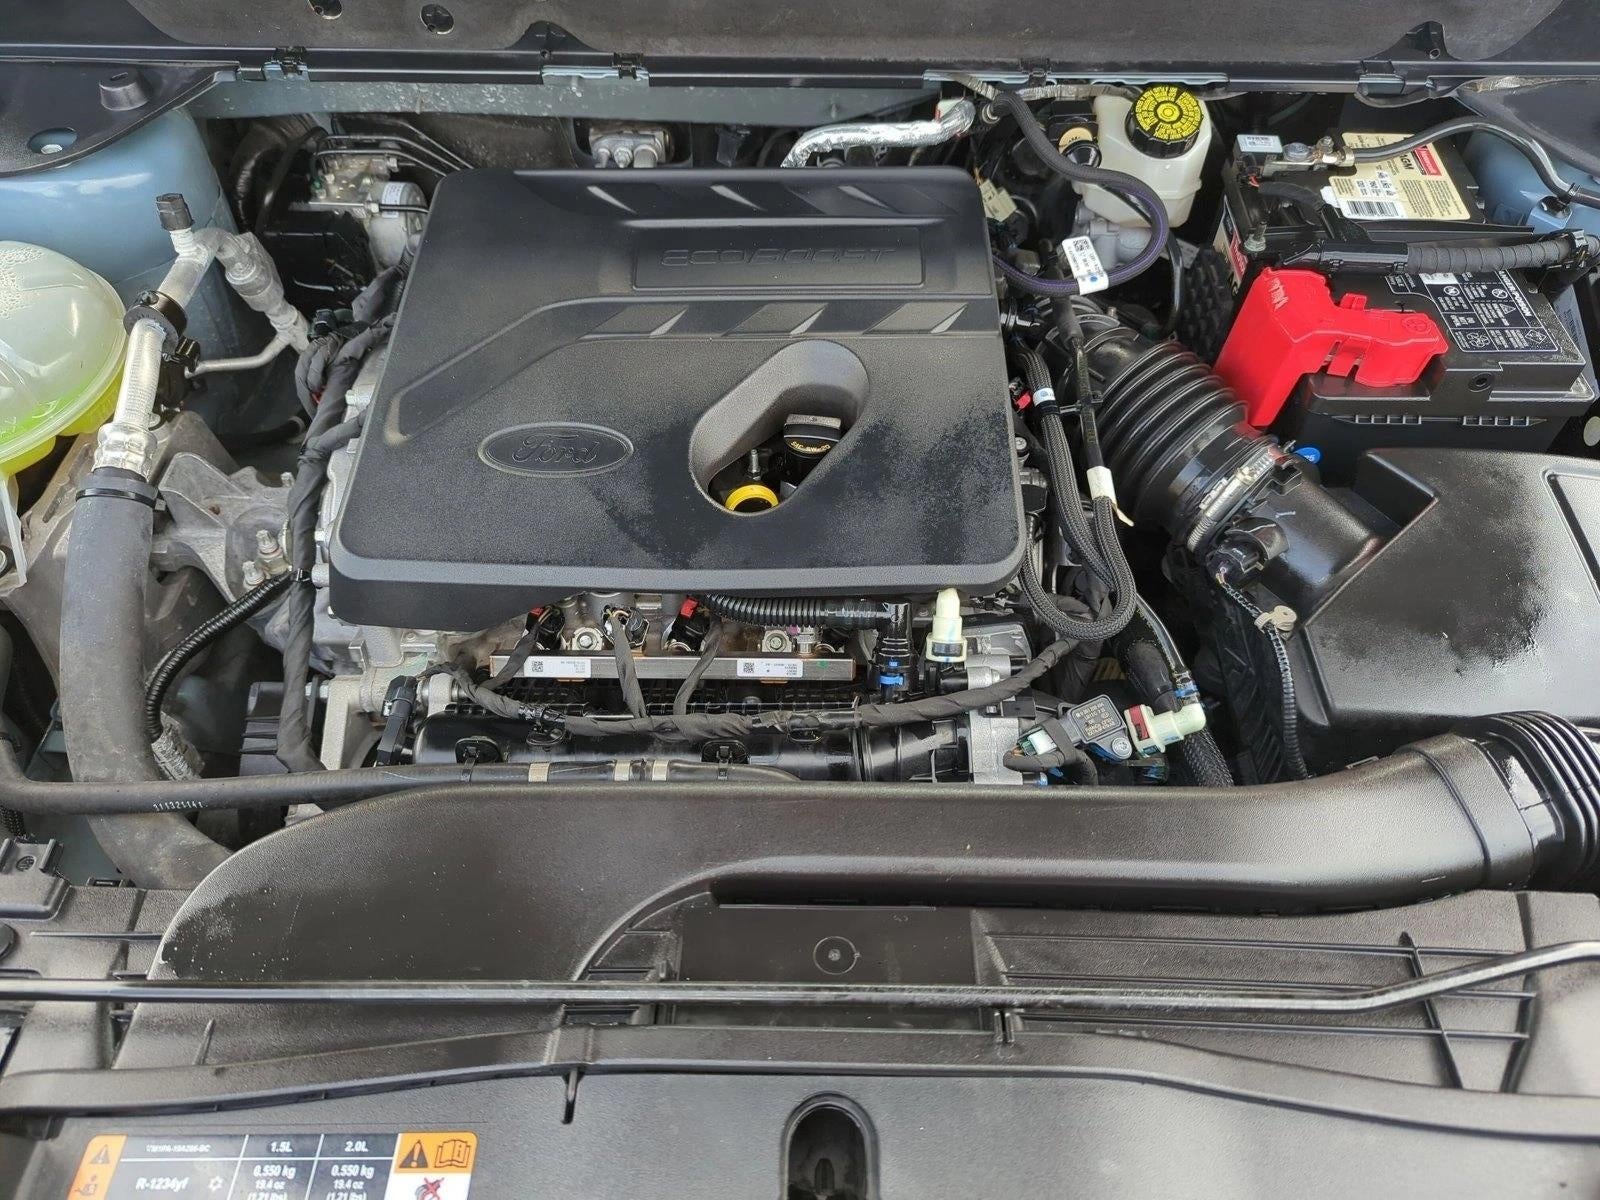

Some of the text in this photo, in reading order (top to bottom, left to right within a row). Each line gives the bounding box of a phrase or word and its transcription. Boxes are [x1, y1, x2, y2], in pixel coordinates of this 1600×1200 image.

[660, 247, 897, 267] ECOBOOST
[511, 433, 600, 464] Ford
[270, 1140, 293, 1153] 1.5L
[344, 1140, 369, 1153] 2.0L
[283, 1165, 297, 1179] kg
[360, 1165, 375, 1179] kg
[135, 1176, 189, 1192] R-1234yf
